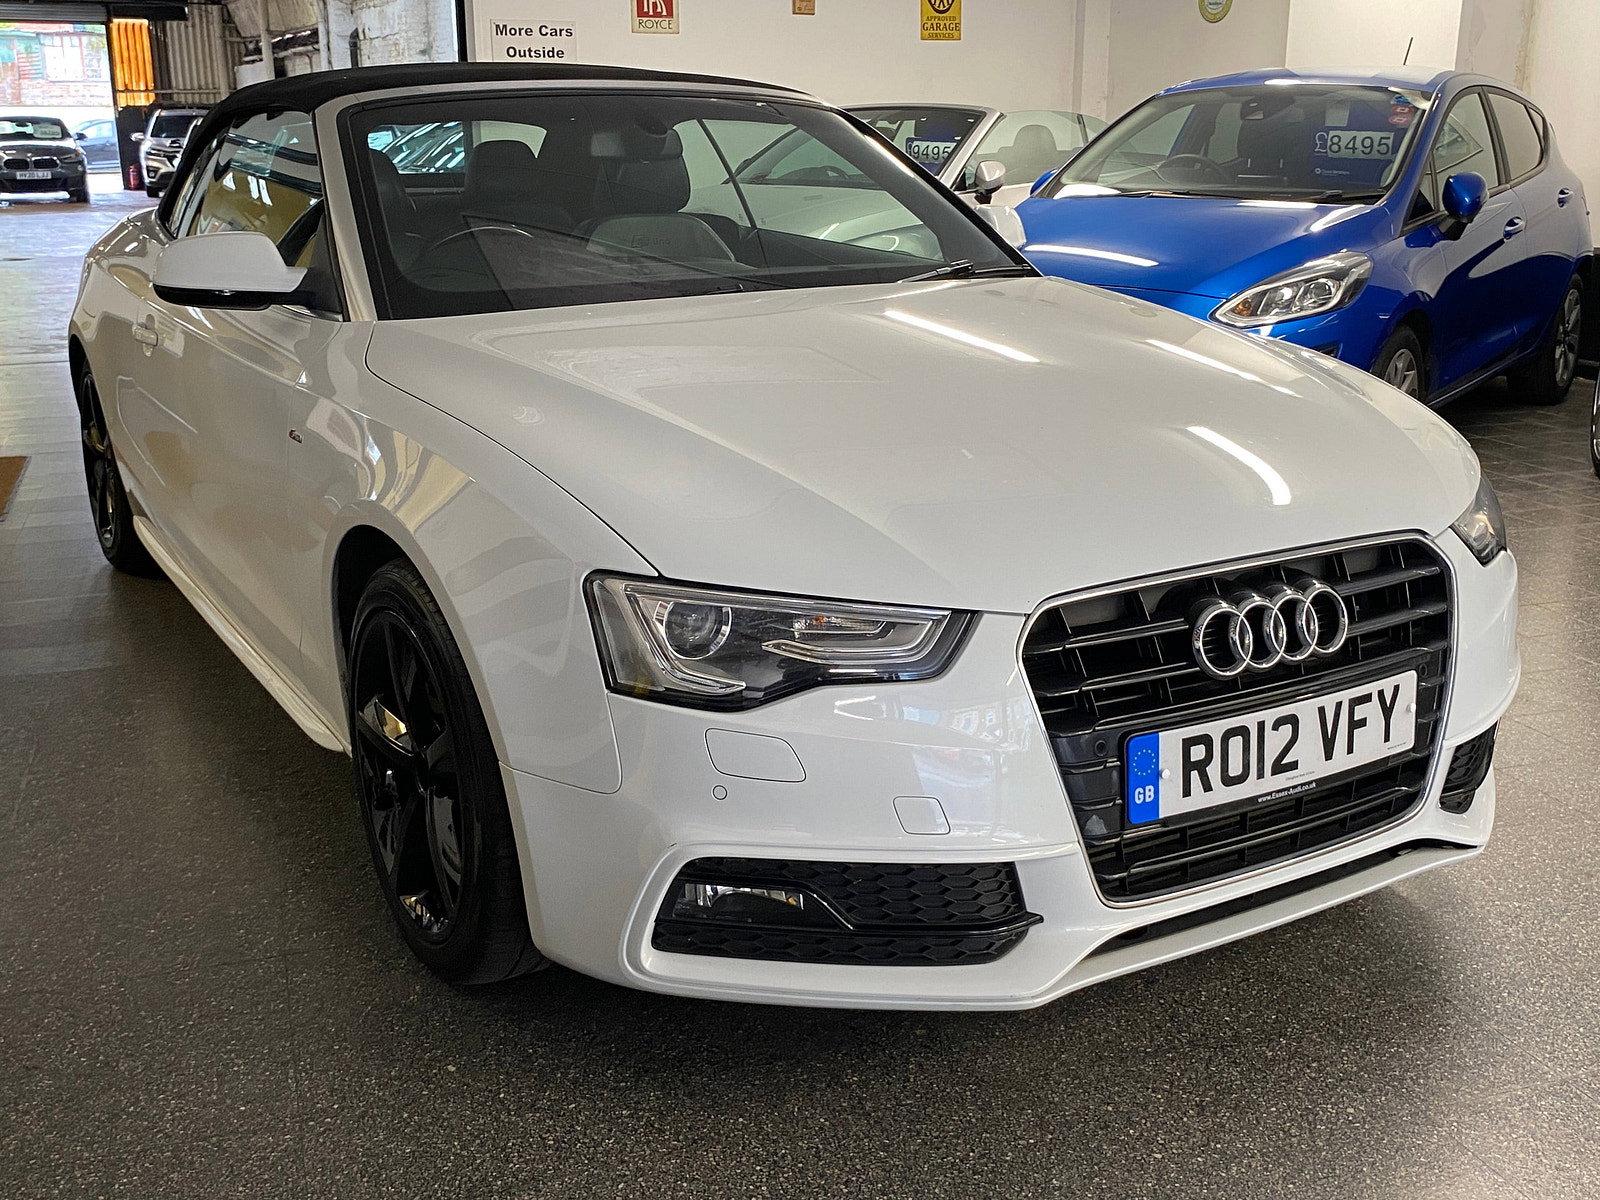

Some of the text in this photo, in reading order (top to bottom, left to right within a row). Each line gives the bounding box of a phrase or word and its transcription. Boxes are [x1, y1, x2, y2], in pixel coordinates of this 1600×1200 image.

[495, 24, 573, 37] More Cars
[638, 19, 672, 29] ROYCE
[922, 23, 960, 31] GARAGE
[506, 46, 564, 58] Outside
[1315, 132, 1390, 155] £8495
[1181, 684, 1401, 799] RO12 VFY
[1134, 785, 1155, 804] GB
